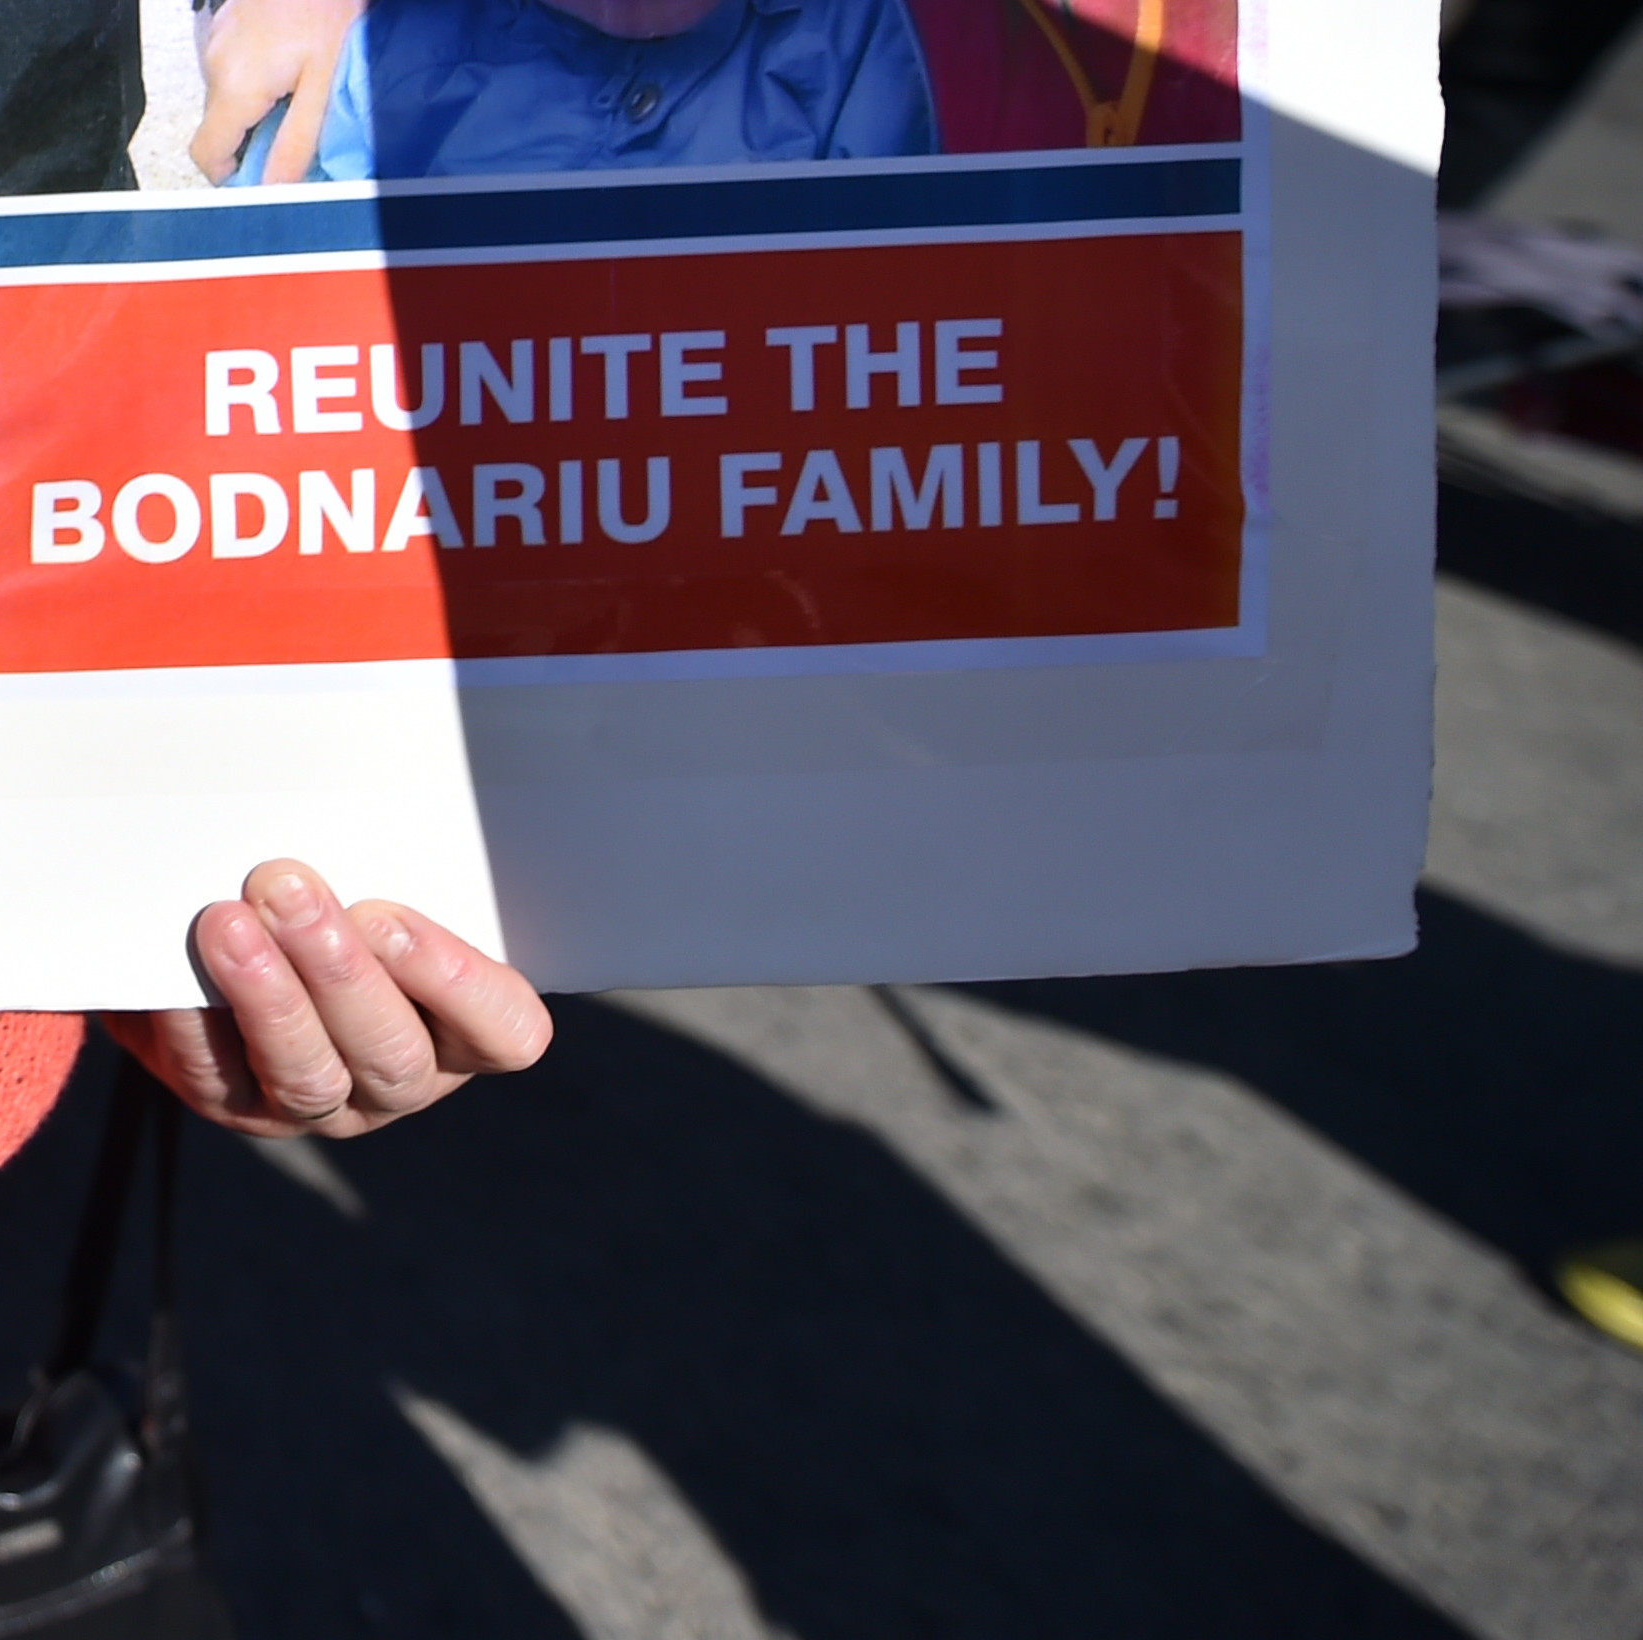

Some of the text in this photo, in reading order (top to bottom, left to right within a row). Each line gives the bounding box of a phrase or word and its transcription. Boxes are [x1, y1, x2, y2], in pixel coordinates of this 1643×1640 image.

[203, 318, 1005, 437] REUNITE THE
[29, 435, 1182, 564] BODNARIU FAMILY!
